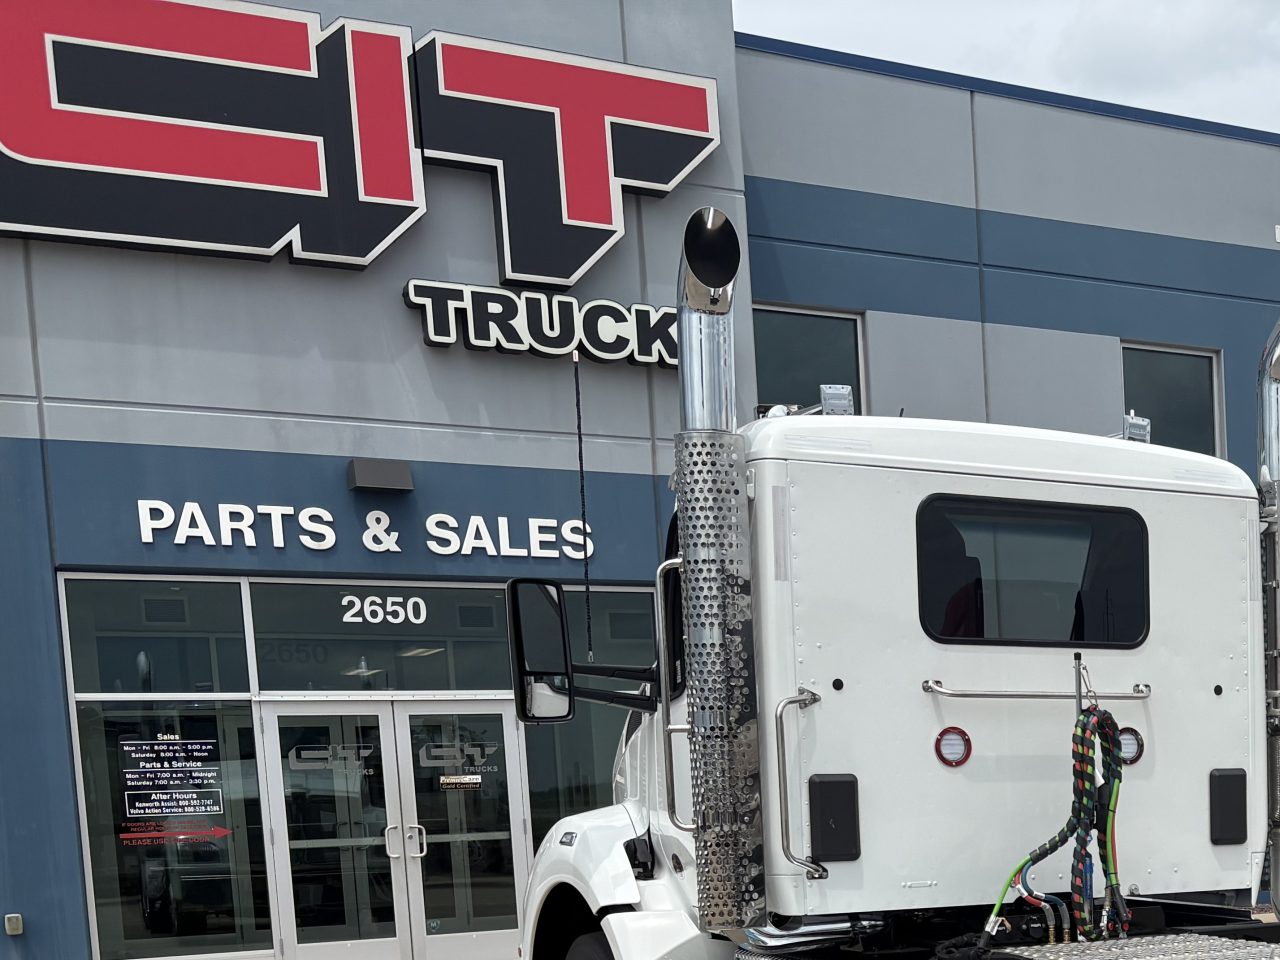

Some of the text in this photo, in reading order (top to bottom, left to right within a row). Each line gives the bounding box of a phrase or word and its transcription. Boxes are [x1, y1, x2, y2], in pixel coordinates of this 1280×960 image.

[0, 0, 720, 287] CIT
[403, 280, 679, 365] TRUCK
[137, 499, 595, 561] PARTS & SALES
[341, 595, 427, 624] 2650
[263, 643, 329, 664] 2650
[140, 761, 161, 769] Parts
[419, 742, 498, 767] CIT
[464, 765, 498, 773] TRUCKS
[123, 838, 152, 846] PLEASE
